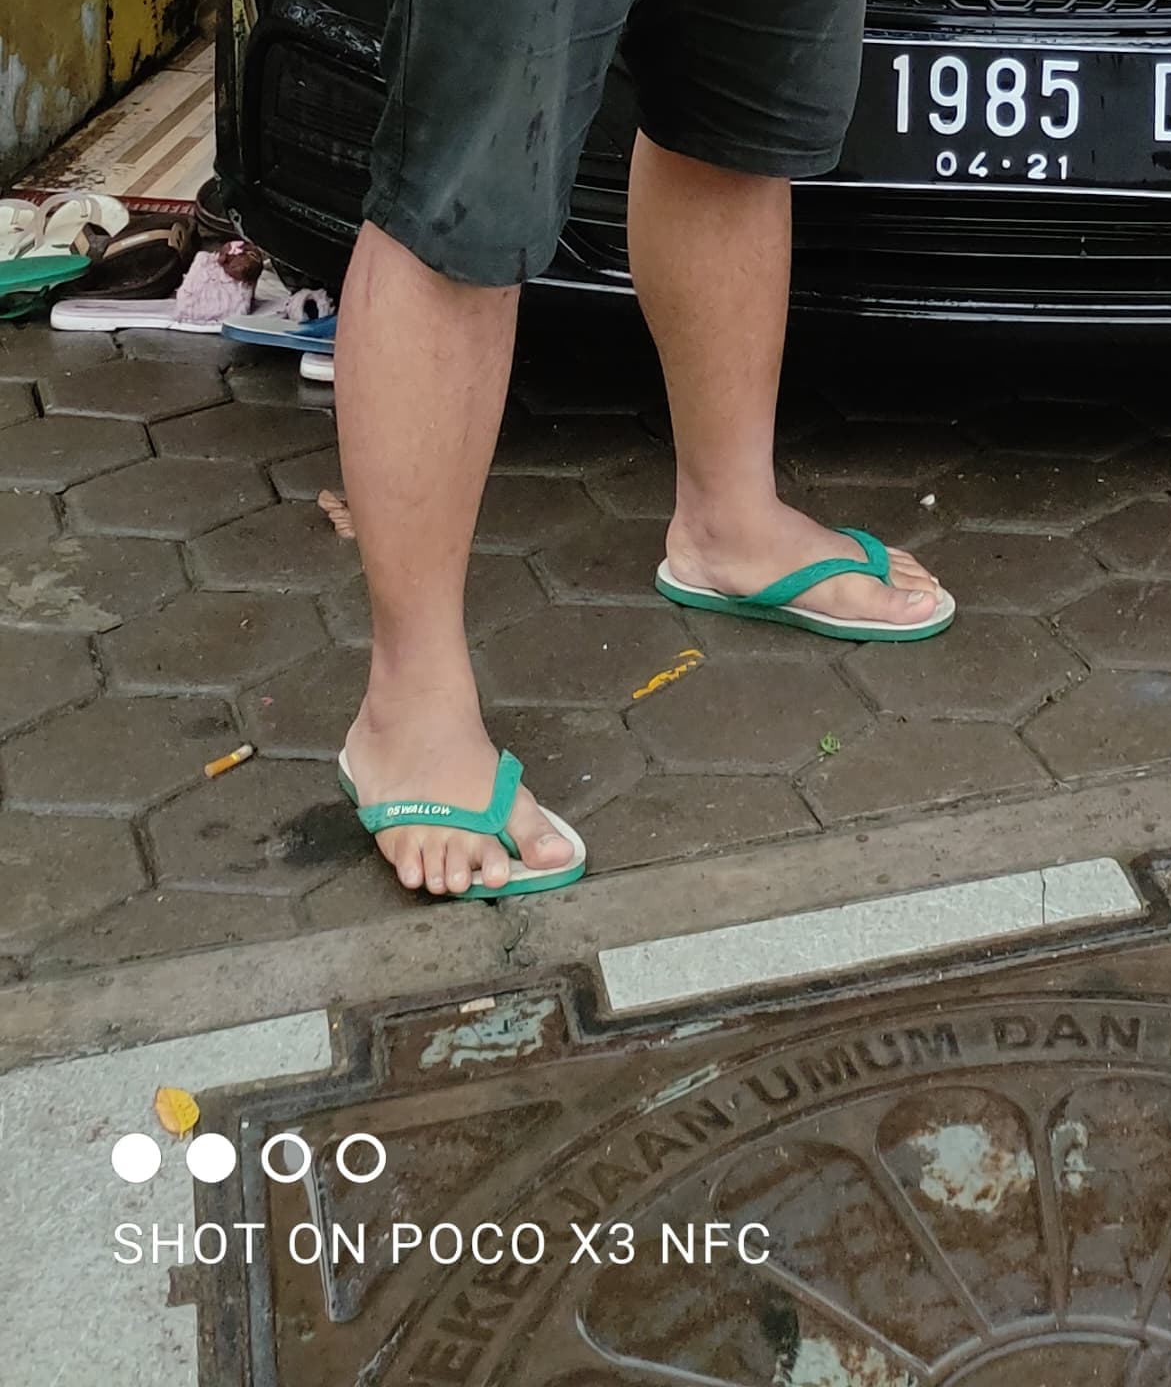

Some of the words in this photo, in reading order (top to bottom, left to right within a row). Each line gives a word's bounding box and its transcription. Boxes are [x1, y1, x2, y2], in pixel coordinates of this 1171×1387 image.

[892, 54, 1080, 140] 1985
[744, 1022, 962, 1105] UMUM
[990, 1012, 1142, 1051] DAN
